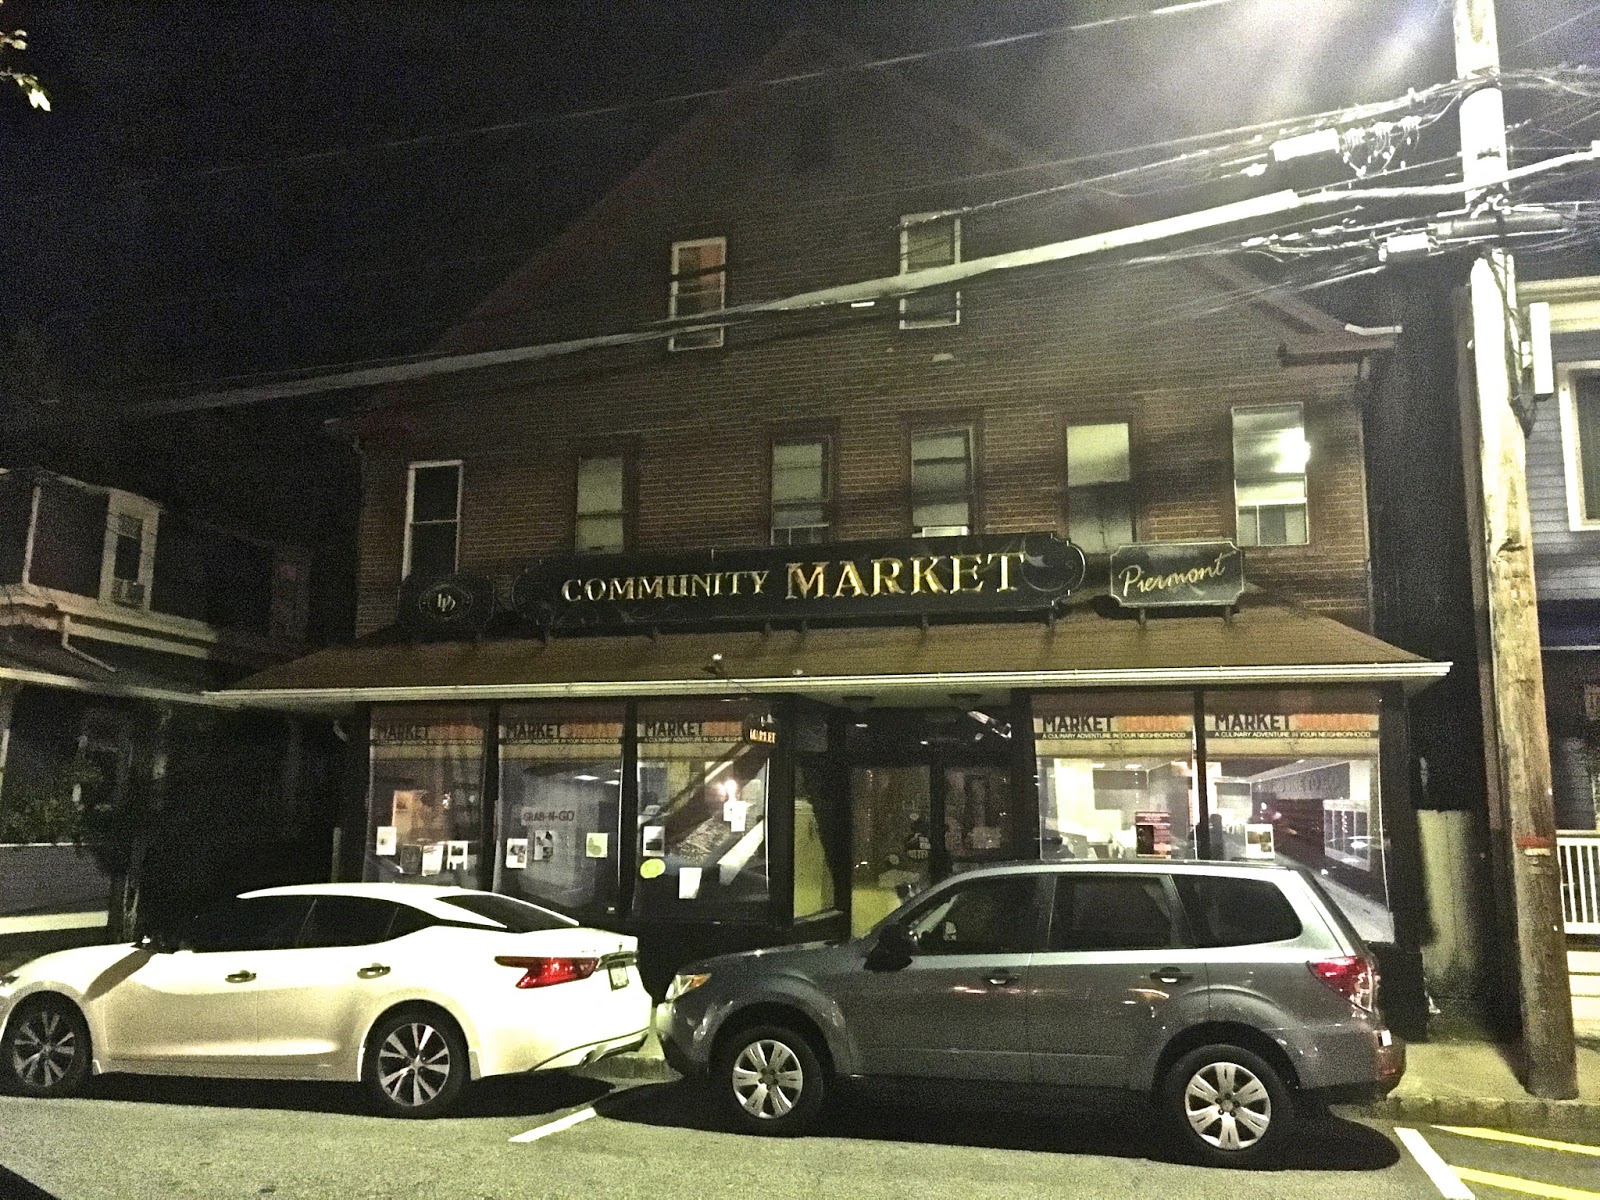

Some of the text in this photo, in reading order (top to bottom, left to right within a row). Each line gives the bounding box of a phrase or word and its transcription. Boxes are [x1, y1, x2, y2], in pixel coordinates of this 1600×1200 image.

[561, 551, 1025, 603] COMMUNITY MARKET
[1119, 550, 1238, 597] Piermont
[643, 720, 702, 737] MARKET
[1042, 714, 1113, 733] MARKET
[1215, 712, 1290, 731] MARKET
